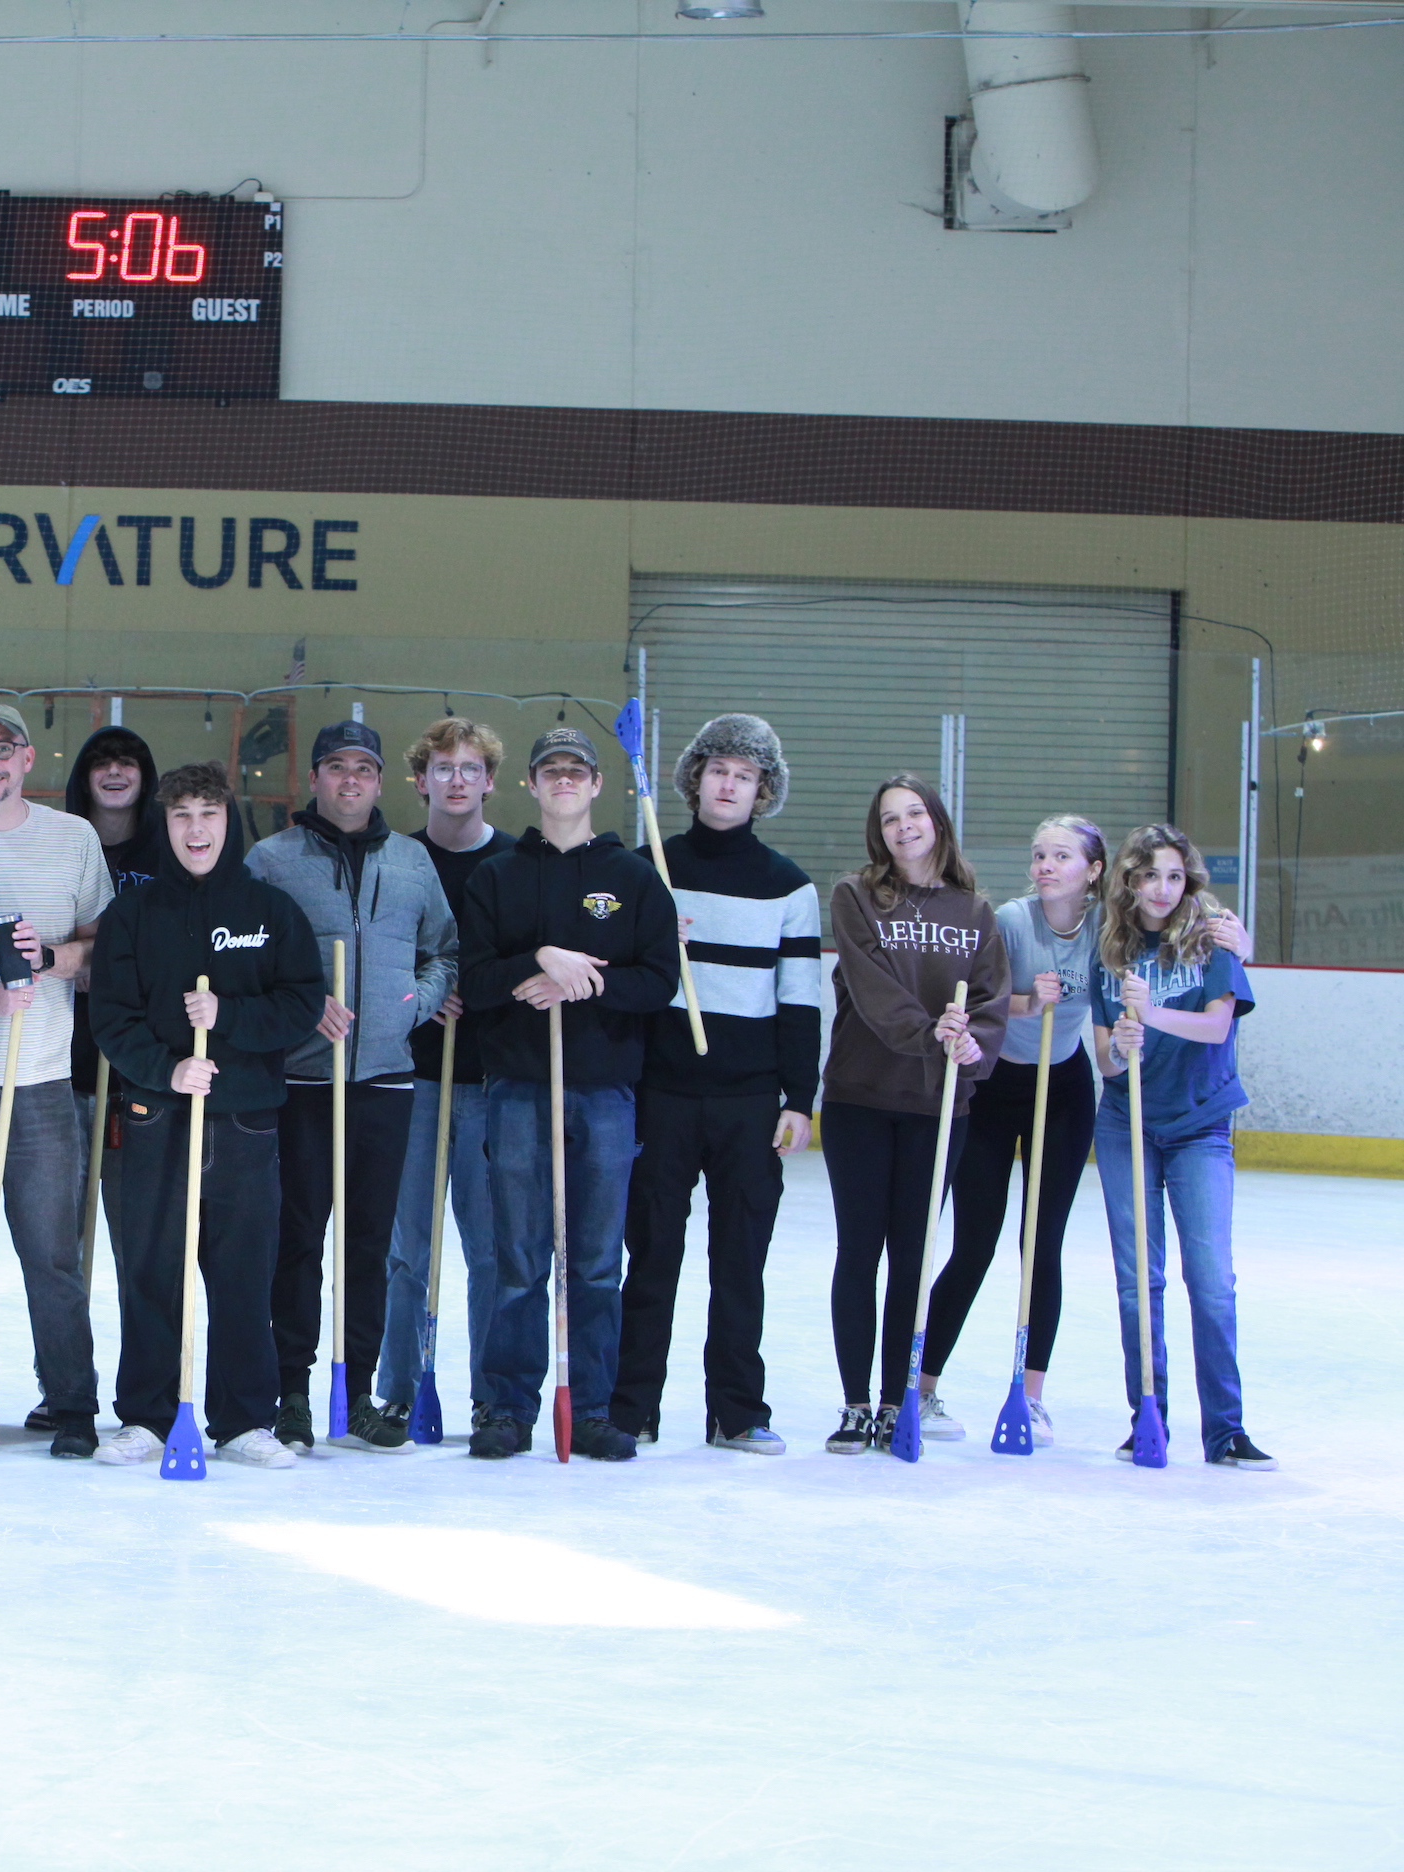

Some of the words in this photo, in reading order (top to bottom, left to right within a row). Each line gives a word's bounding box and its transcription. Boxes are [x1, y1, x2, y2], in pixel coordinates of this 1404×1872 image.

[264, 214, 282, 230] P1
[264, 252, 282, 267] P2
[73, 299, 134, 318] PERIOD
[192, 298, 261, 322] GUEST
[211, 924, 270, 952] Donut
[876, 919, 980, 951] LEHIGH
